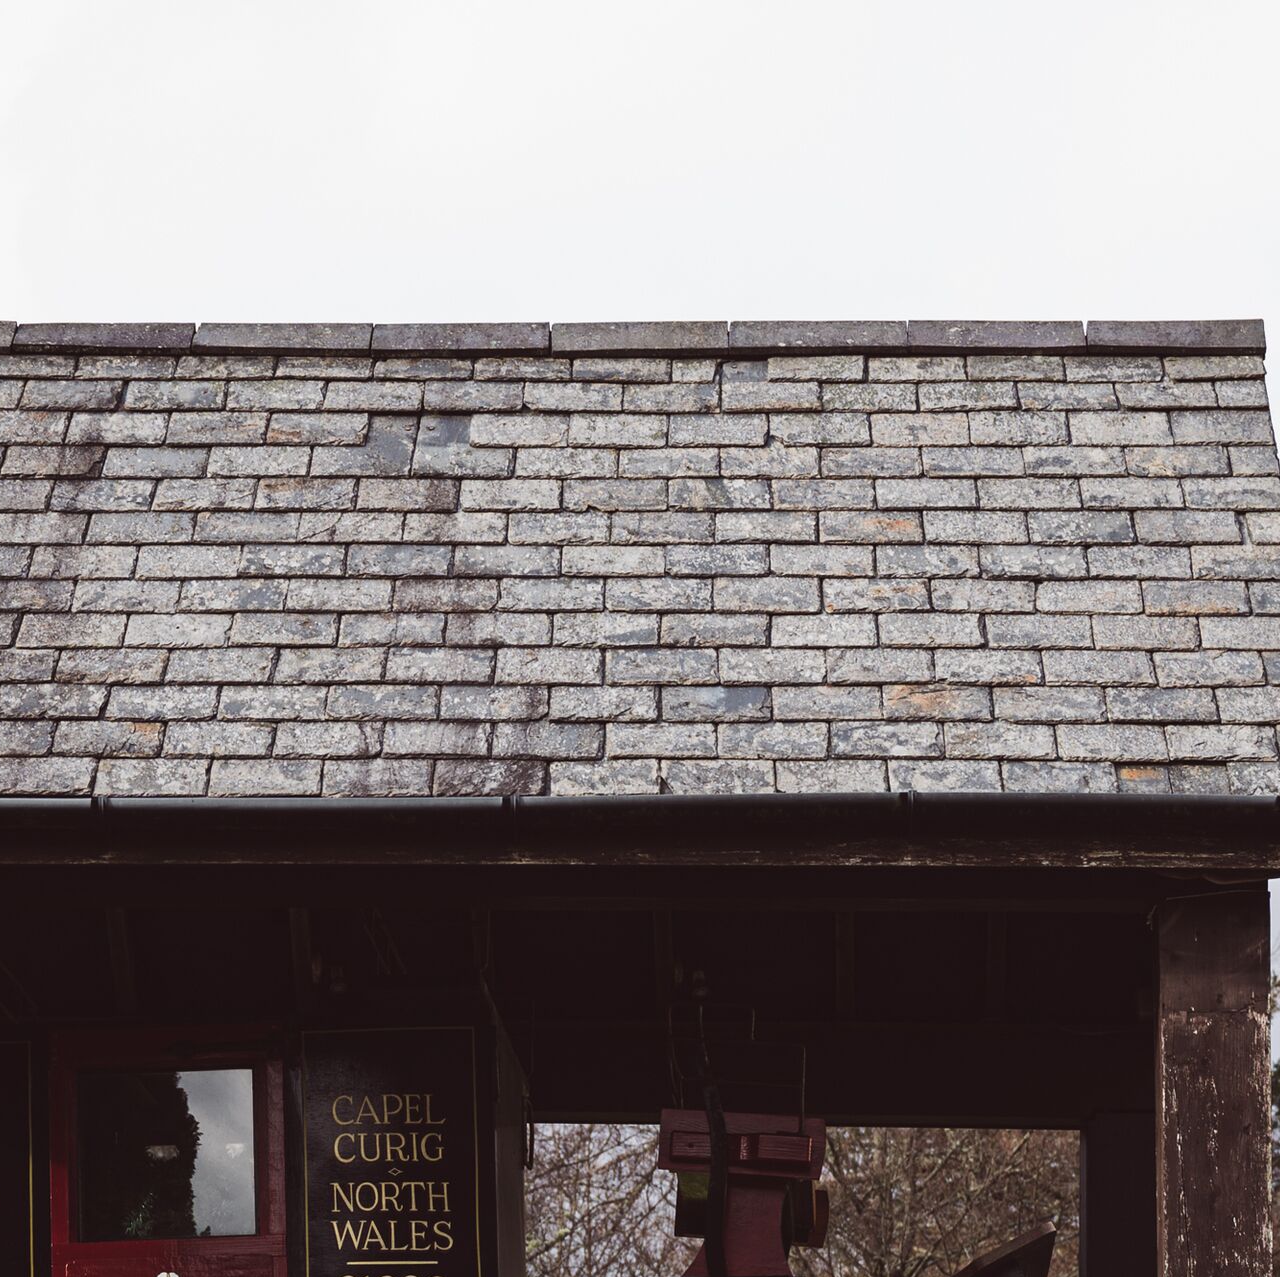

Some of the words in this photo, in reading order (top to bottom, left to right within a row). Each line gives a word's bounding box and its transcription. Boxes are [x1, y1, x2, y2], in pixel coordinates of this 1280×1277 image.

[331, 1094, 446, 1126] CAPEL
[333, 1132, 444, 1163] CURIG
[331, 1181, 451, 1213] NORTH
[331, 1219, 454, 1251] WALES
